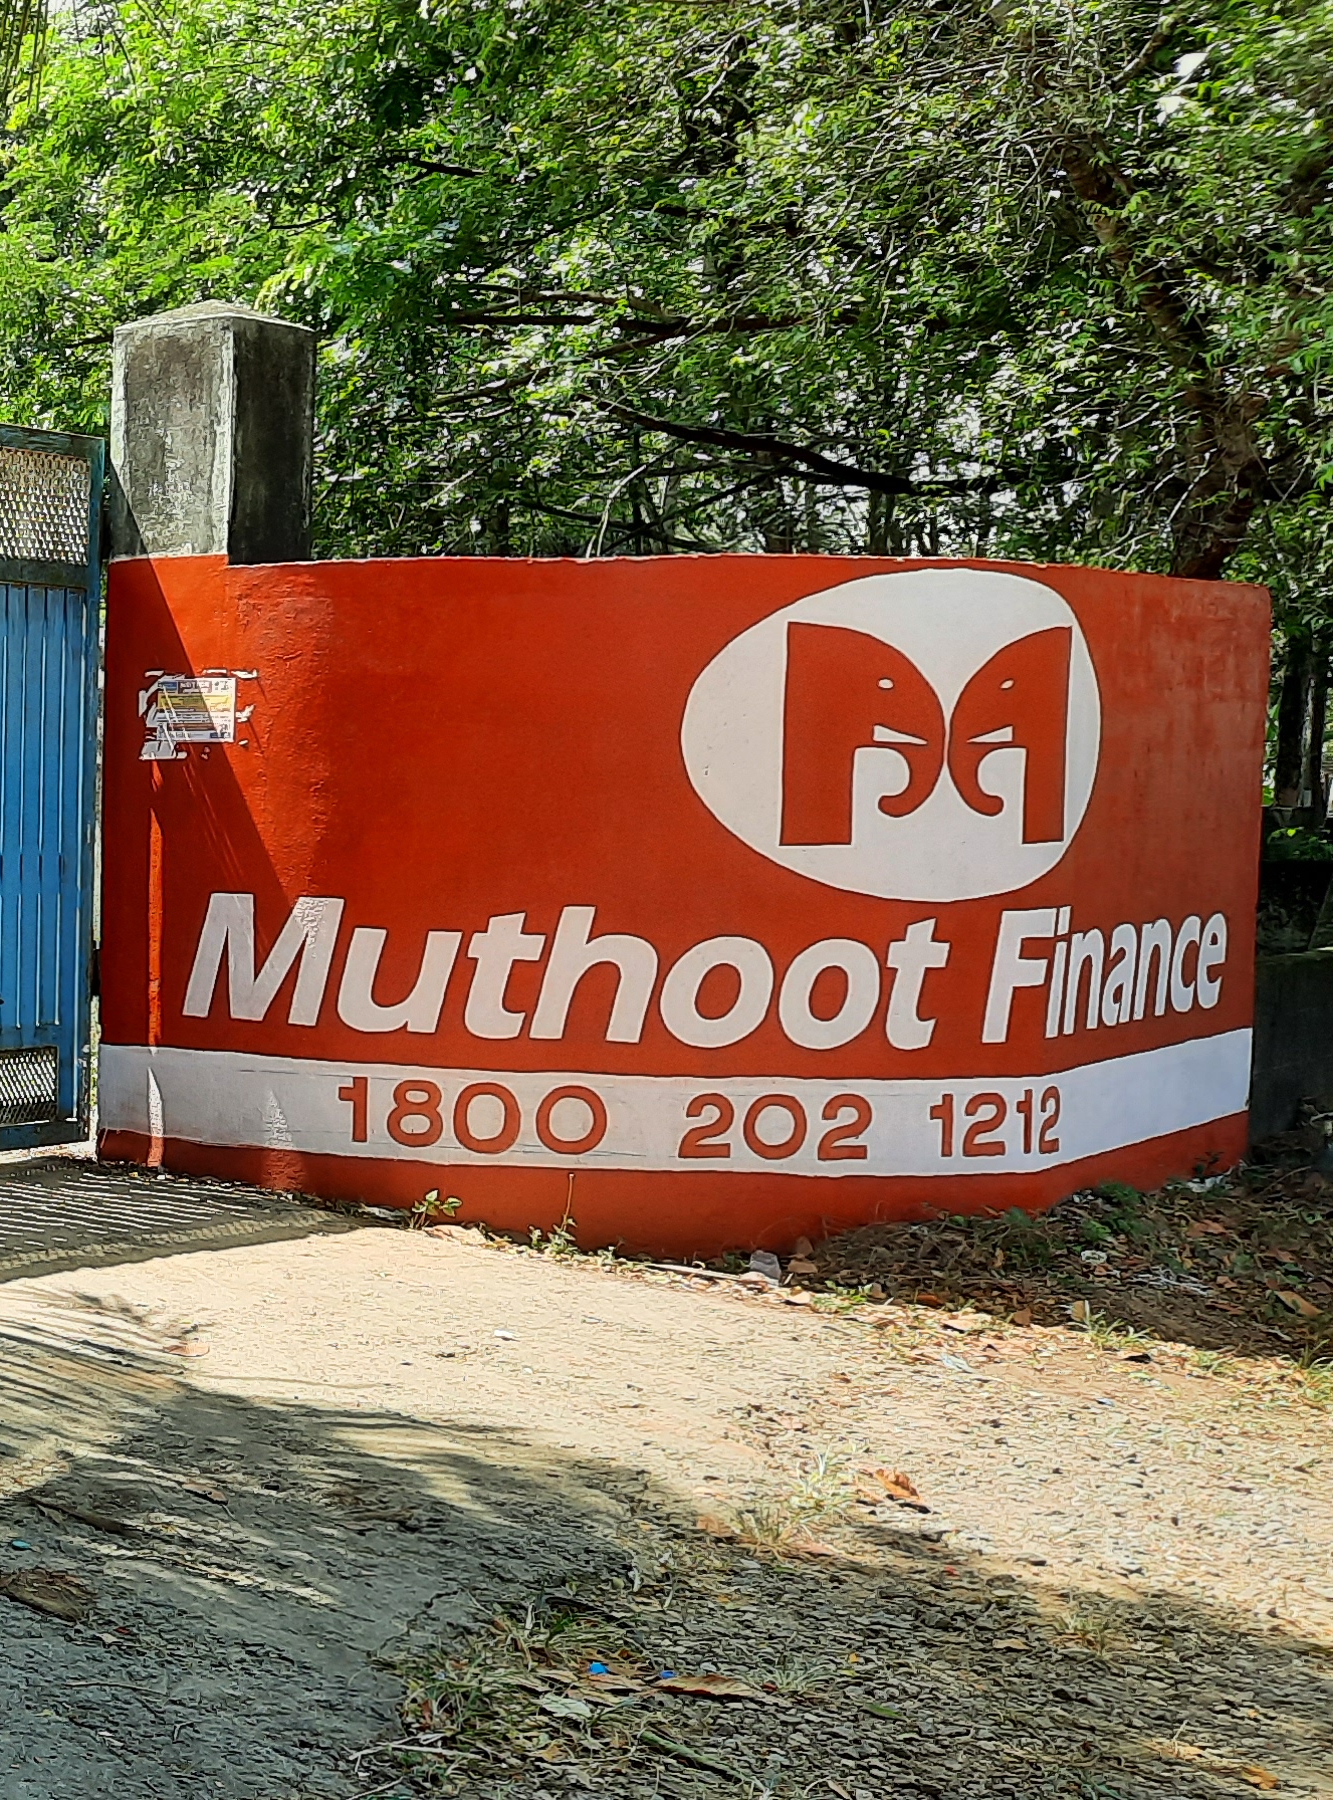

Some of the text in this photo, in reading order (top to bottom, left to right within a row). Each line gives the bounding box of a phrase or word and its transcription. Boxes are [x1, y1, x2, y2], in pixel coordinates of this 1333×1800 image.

[180, 890, 1228, 1051] Muthoot Finance
[336, 1076, 1062, 1162] 1800 202 1212
